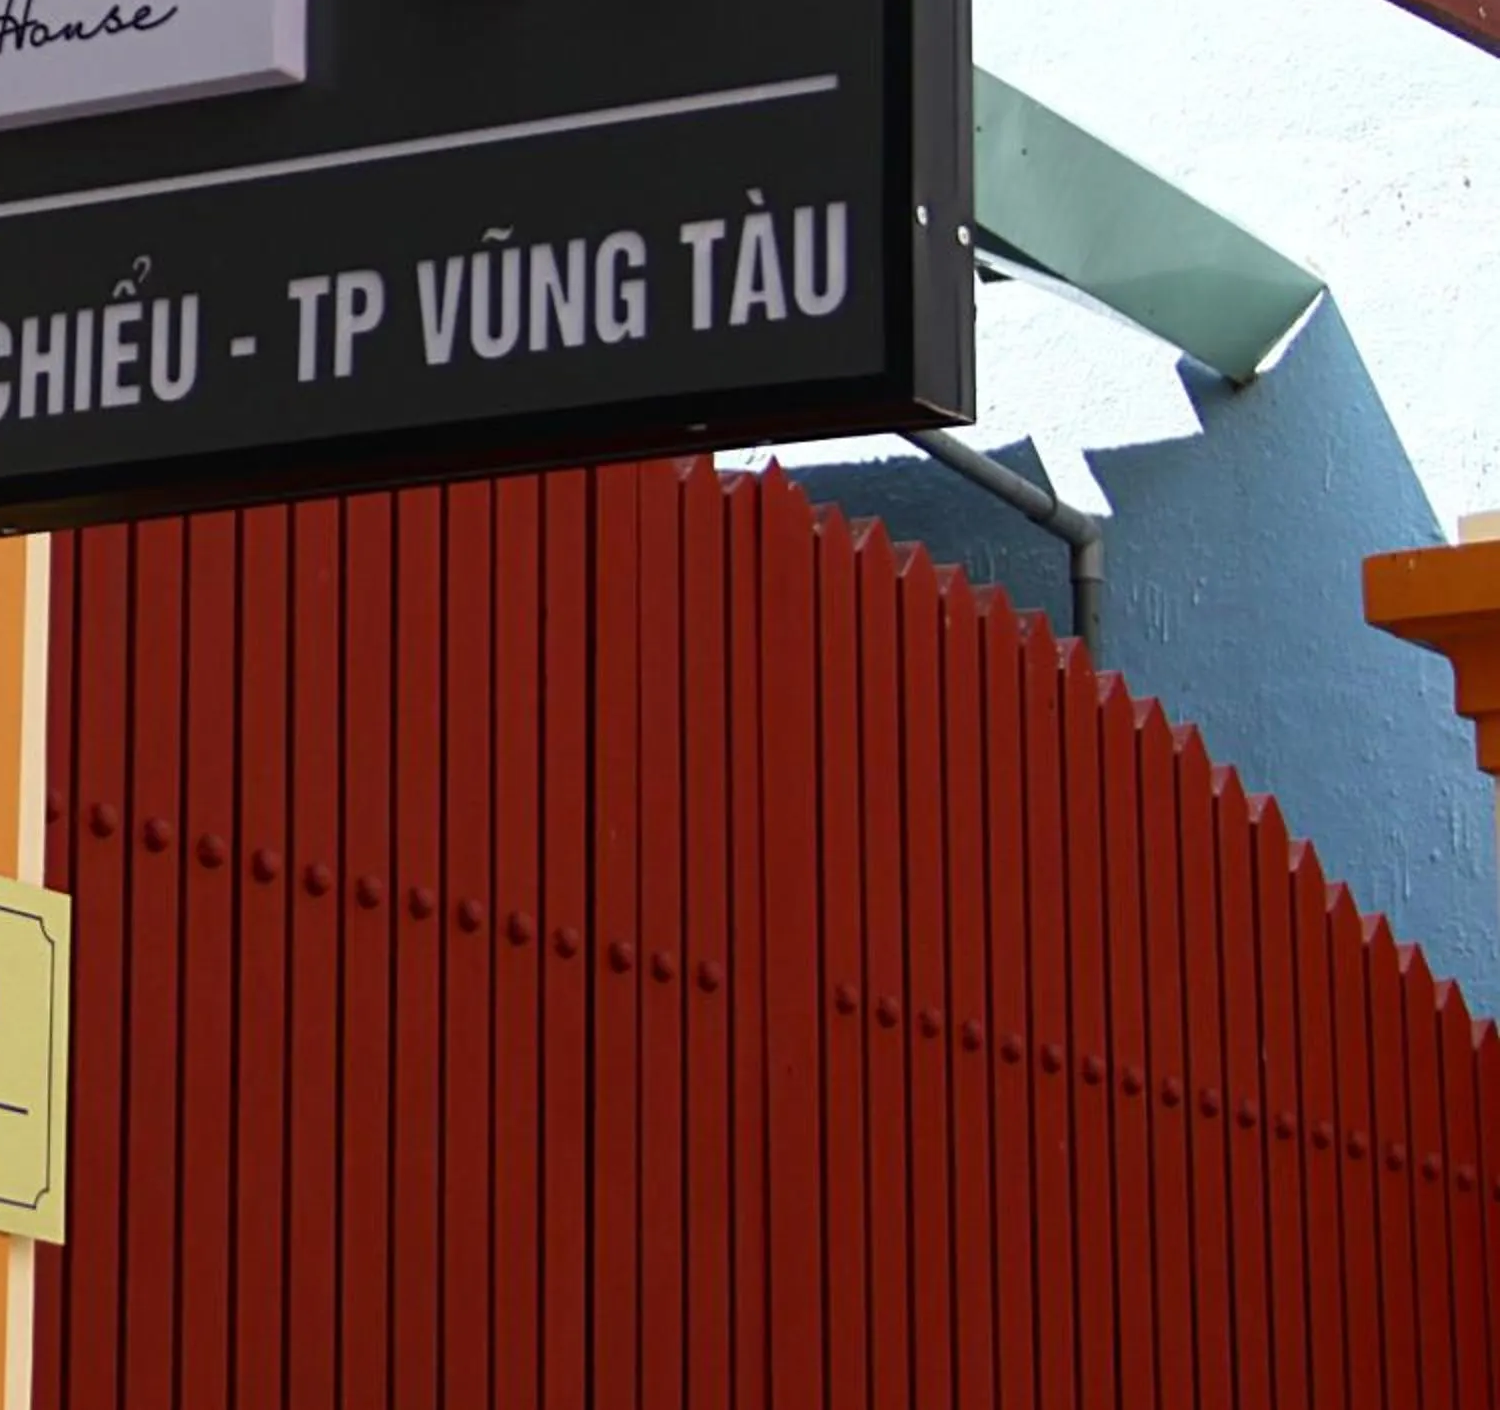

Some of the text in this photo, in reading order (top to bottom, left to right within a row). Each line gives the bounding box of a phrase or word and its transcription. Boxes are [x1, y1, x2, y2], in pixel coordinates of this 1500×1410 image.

[288, 269, 385, 382] TP
[417, 225, 647, 365] VŨNG
[680, 188, 847, 331] TÀU
